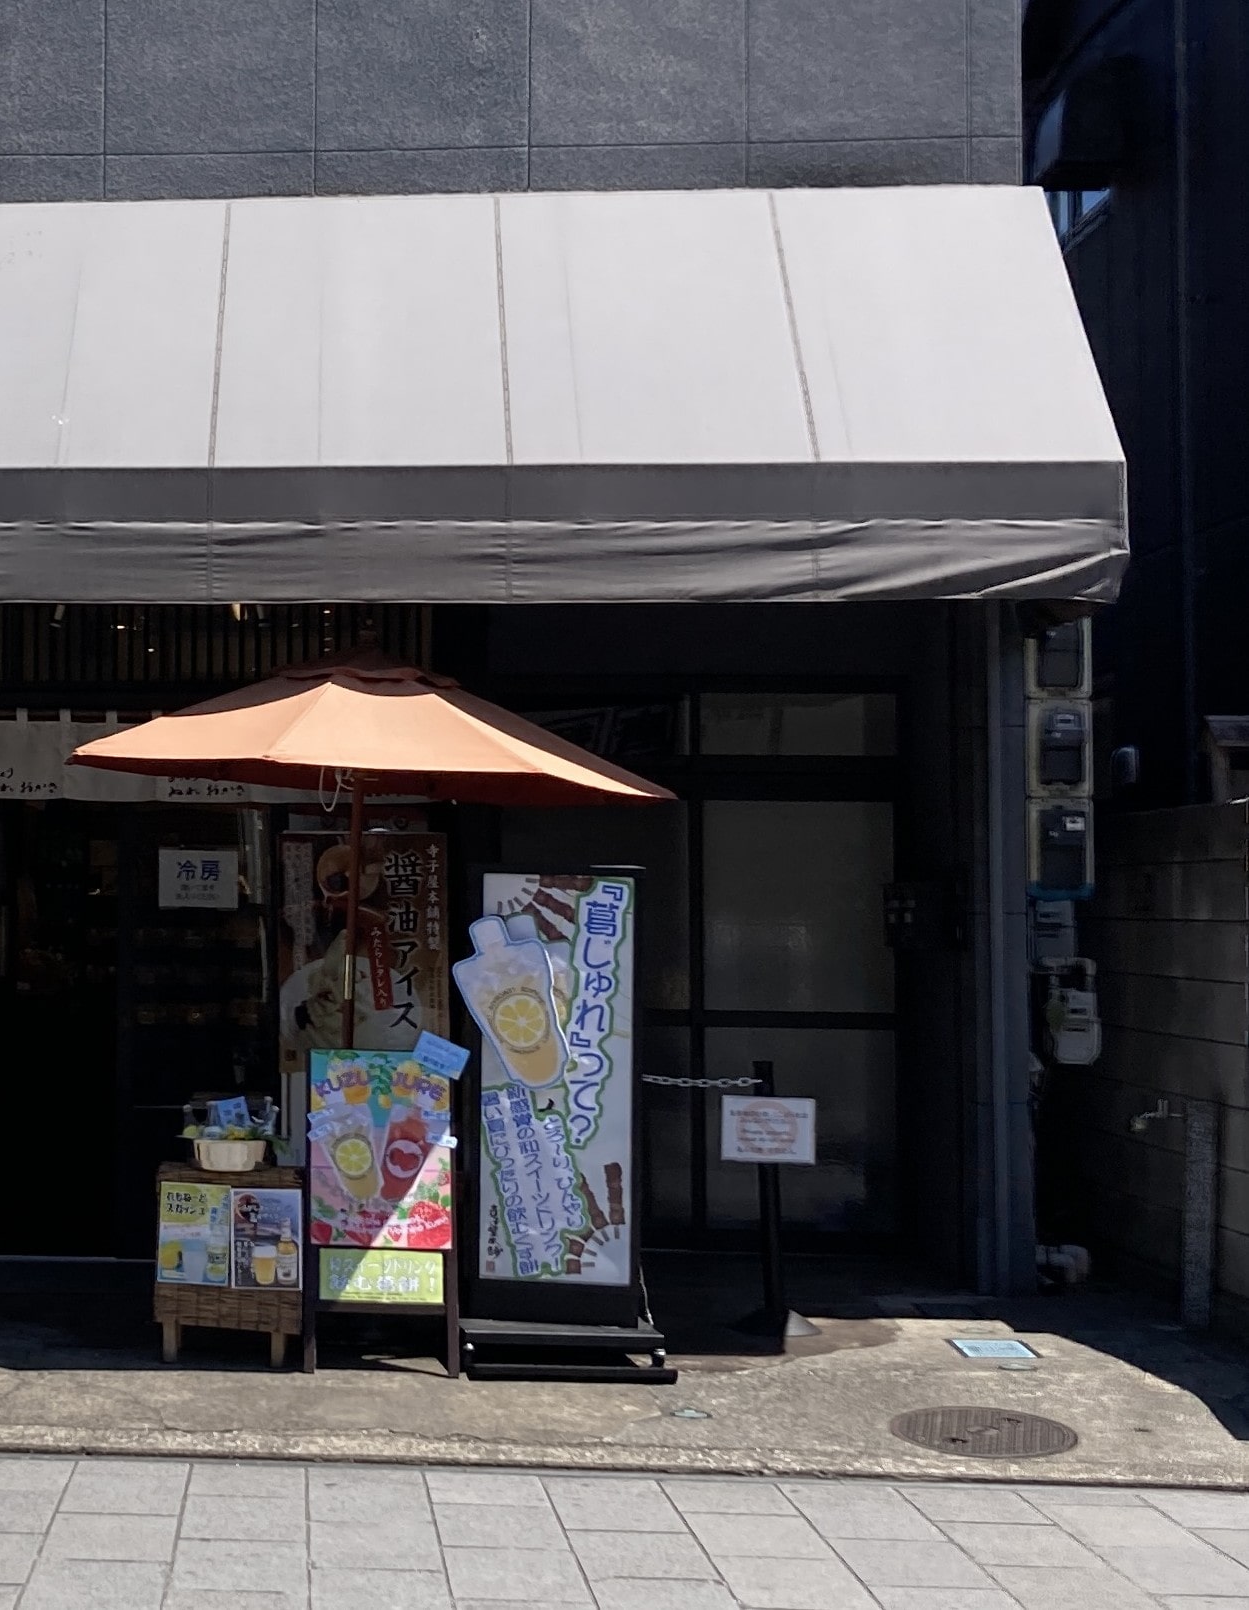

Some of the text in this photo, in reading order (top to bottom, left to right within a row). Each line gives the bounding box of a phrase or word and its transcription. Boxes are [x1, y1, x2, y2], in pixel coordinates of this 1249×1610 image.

[176, 860, 222, 881] 冷房
[383, 851, 424, 1029] 醤油アイス
